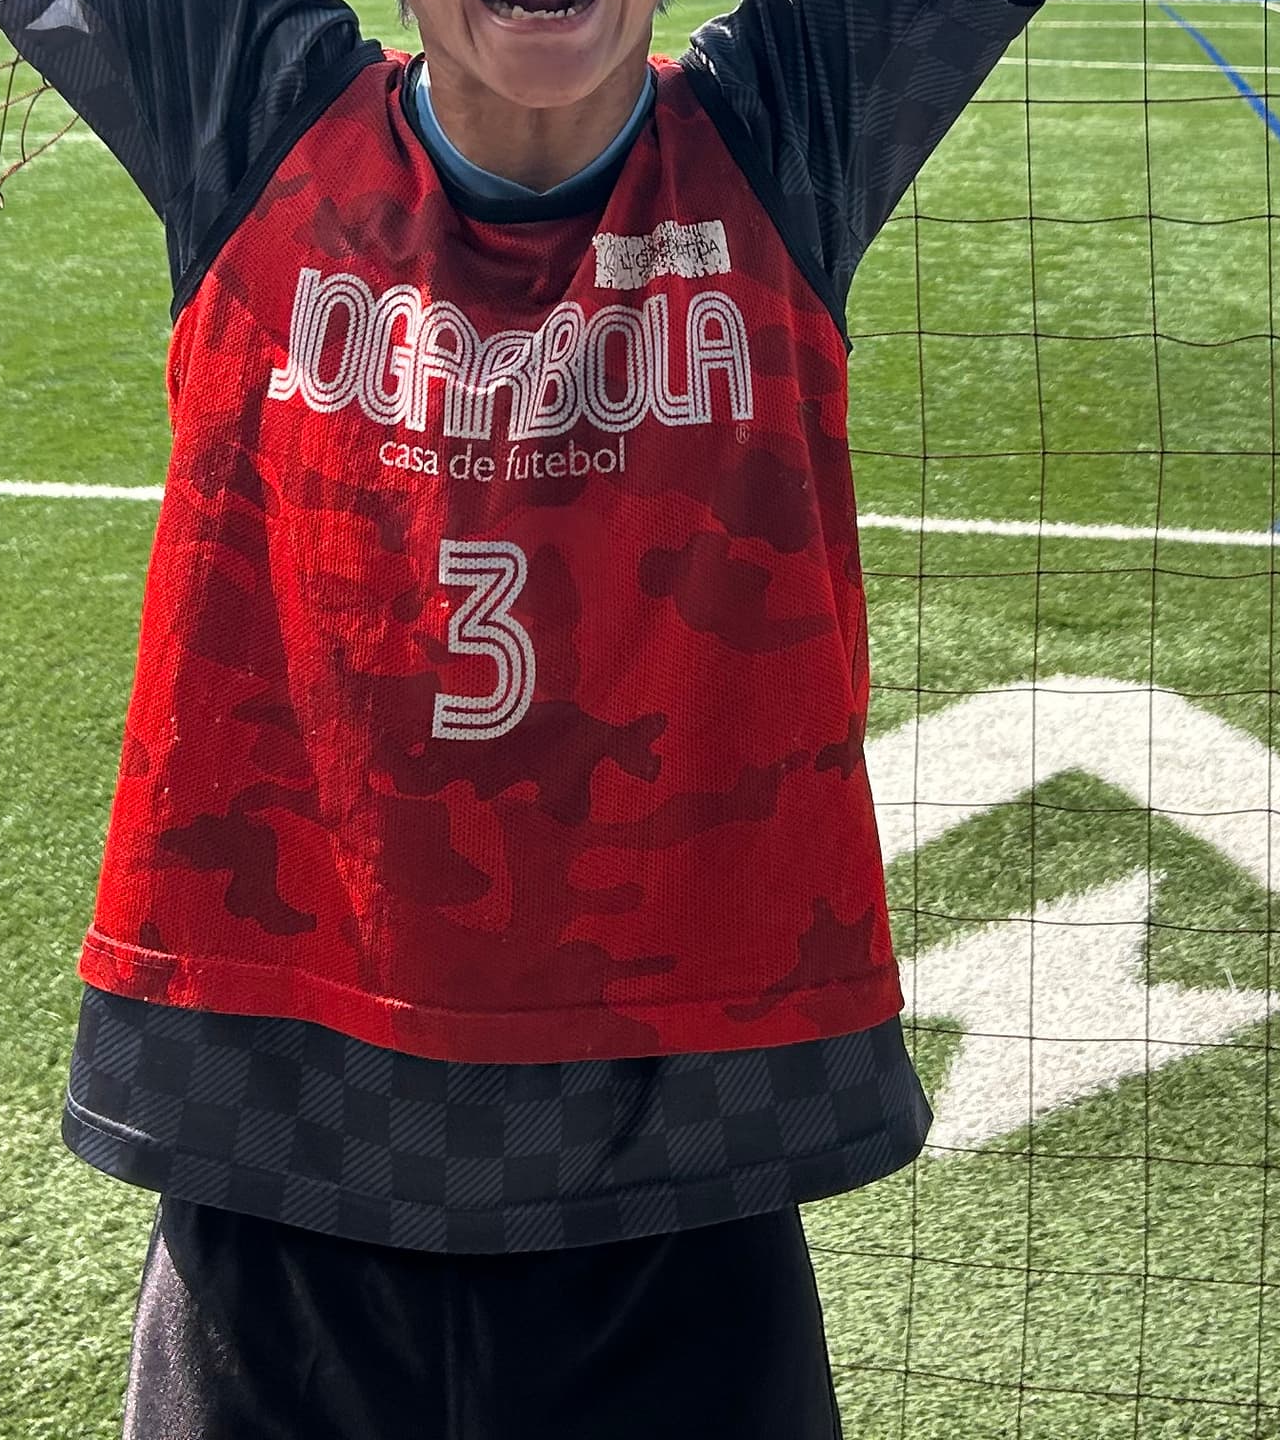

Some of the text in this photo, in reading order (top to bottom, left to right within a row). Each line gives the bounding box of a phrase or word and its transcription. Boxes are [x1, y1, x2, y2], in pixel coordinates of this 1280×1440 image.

[379, 435, 626, 482] casa de futebol
[431, 539, 536, 741] 3
